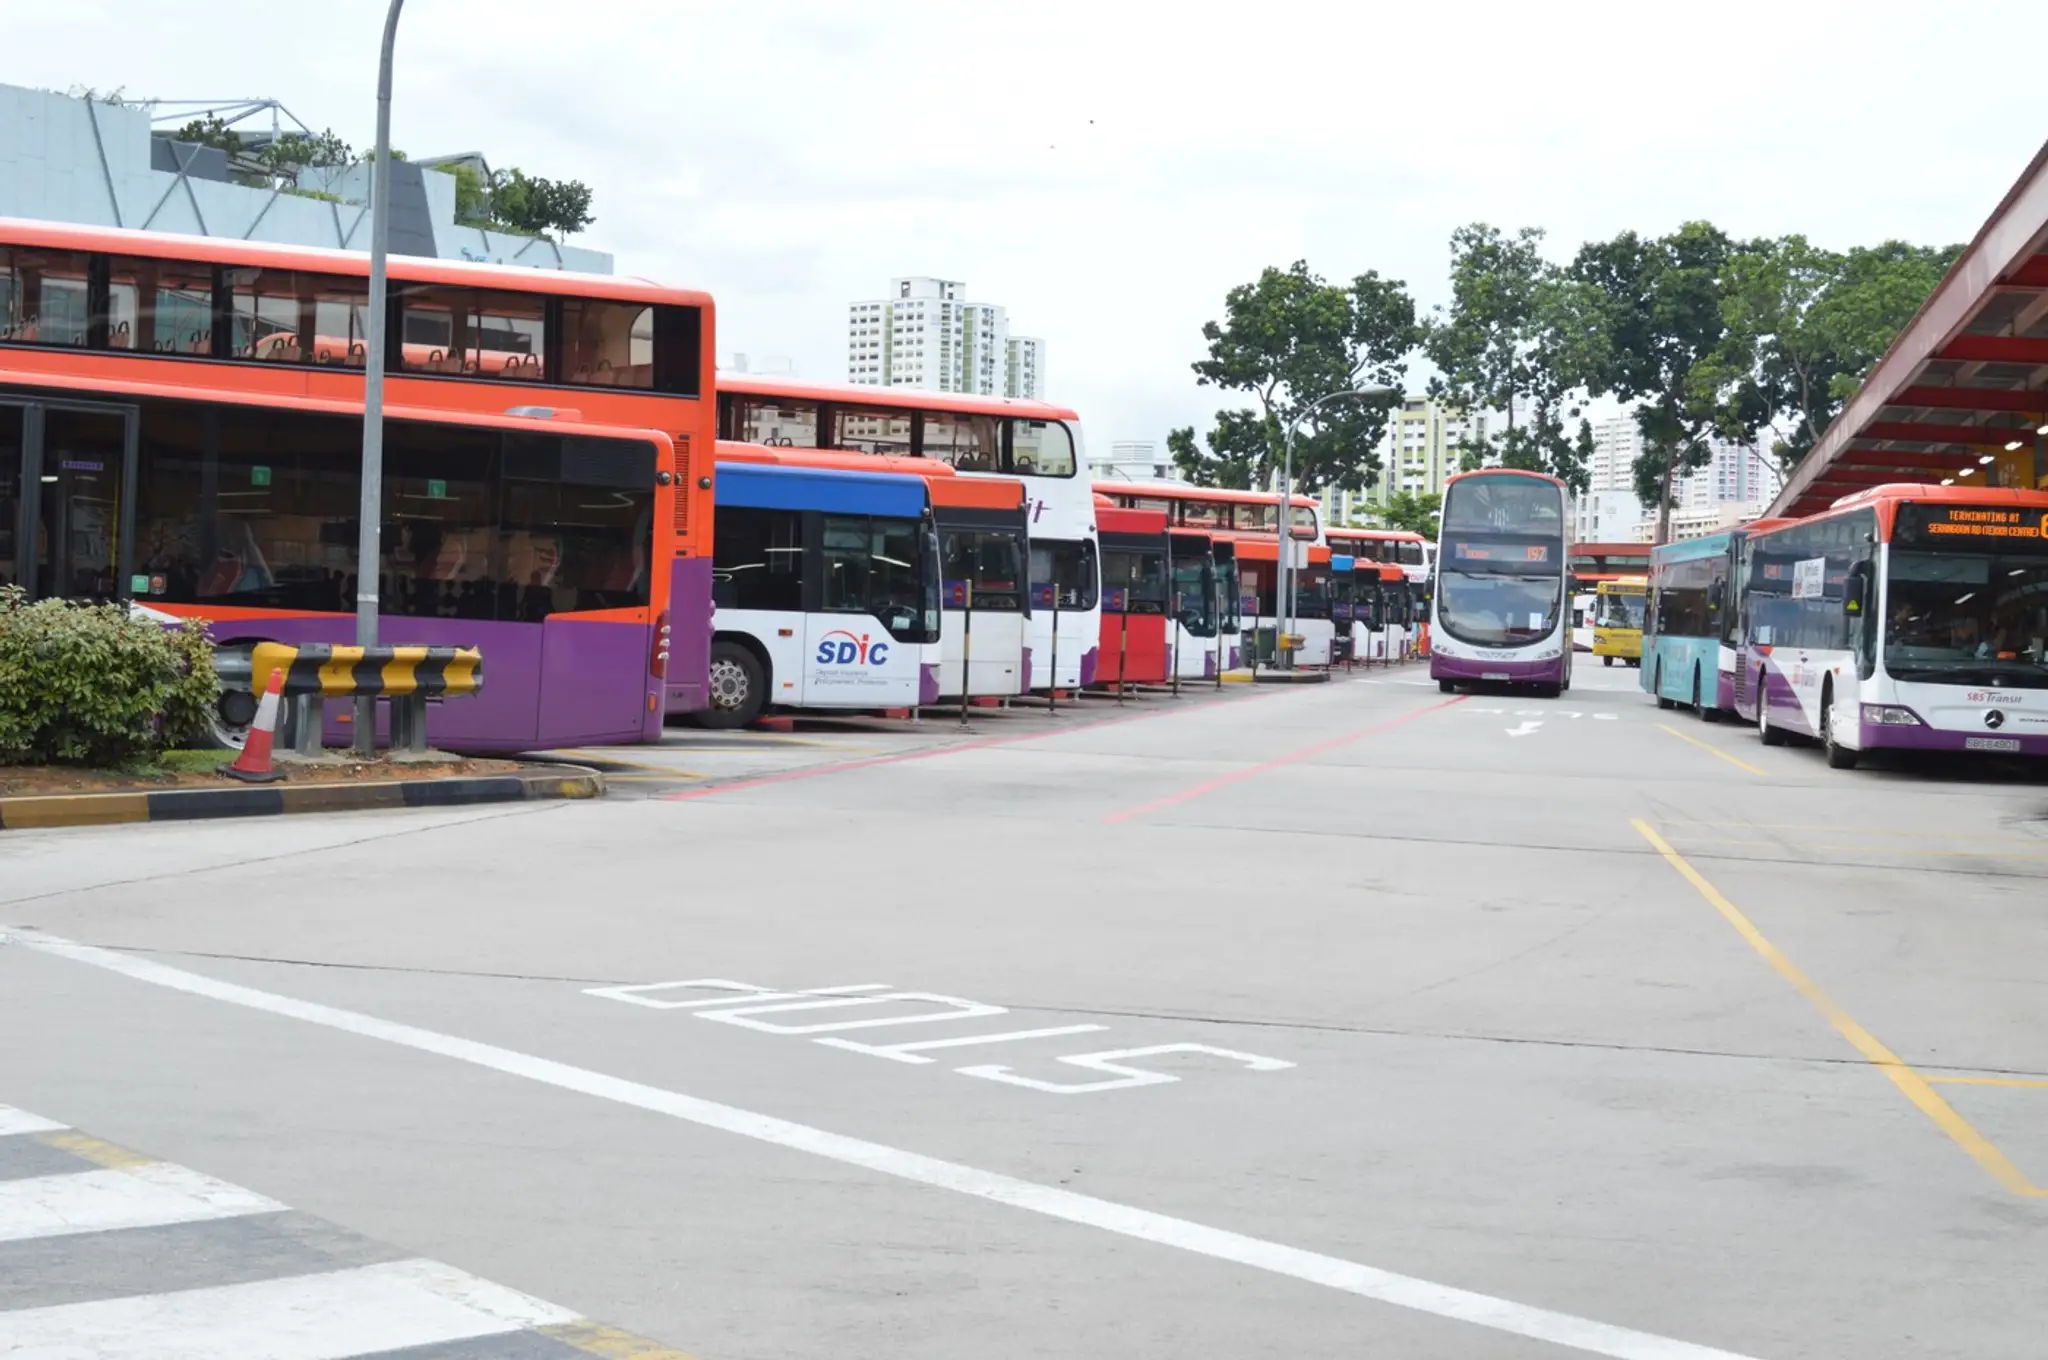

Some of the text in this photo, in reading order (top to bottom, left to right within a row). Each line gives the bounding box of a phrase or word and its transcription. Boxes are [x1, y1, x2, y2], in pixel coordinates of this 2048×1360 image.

[1949, 510, 2020, 523] TERMINATING AT
[1967, 692, 2023, 703] SBS Transit
[581, 978, 1298, 1094] STOP
